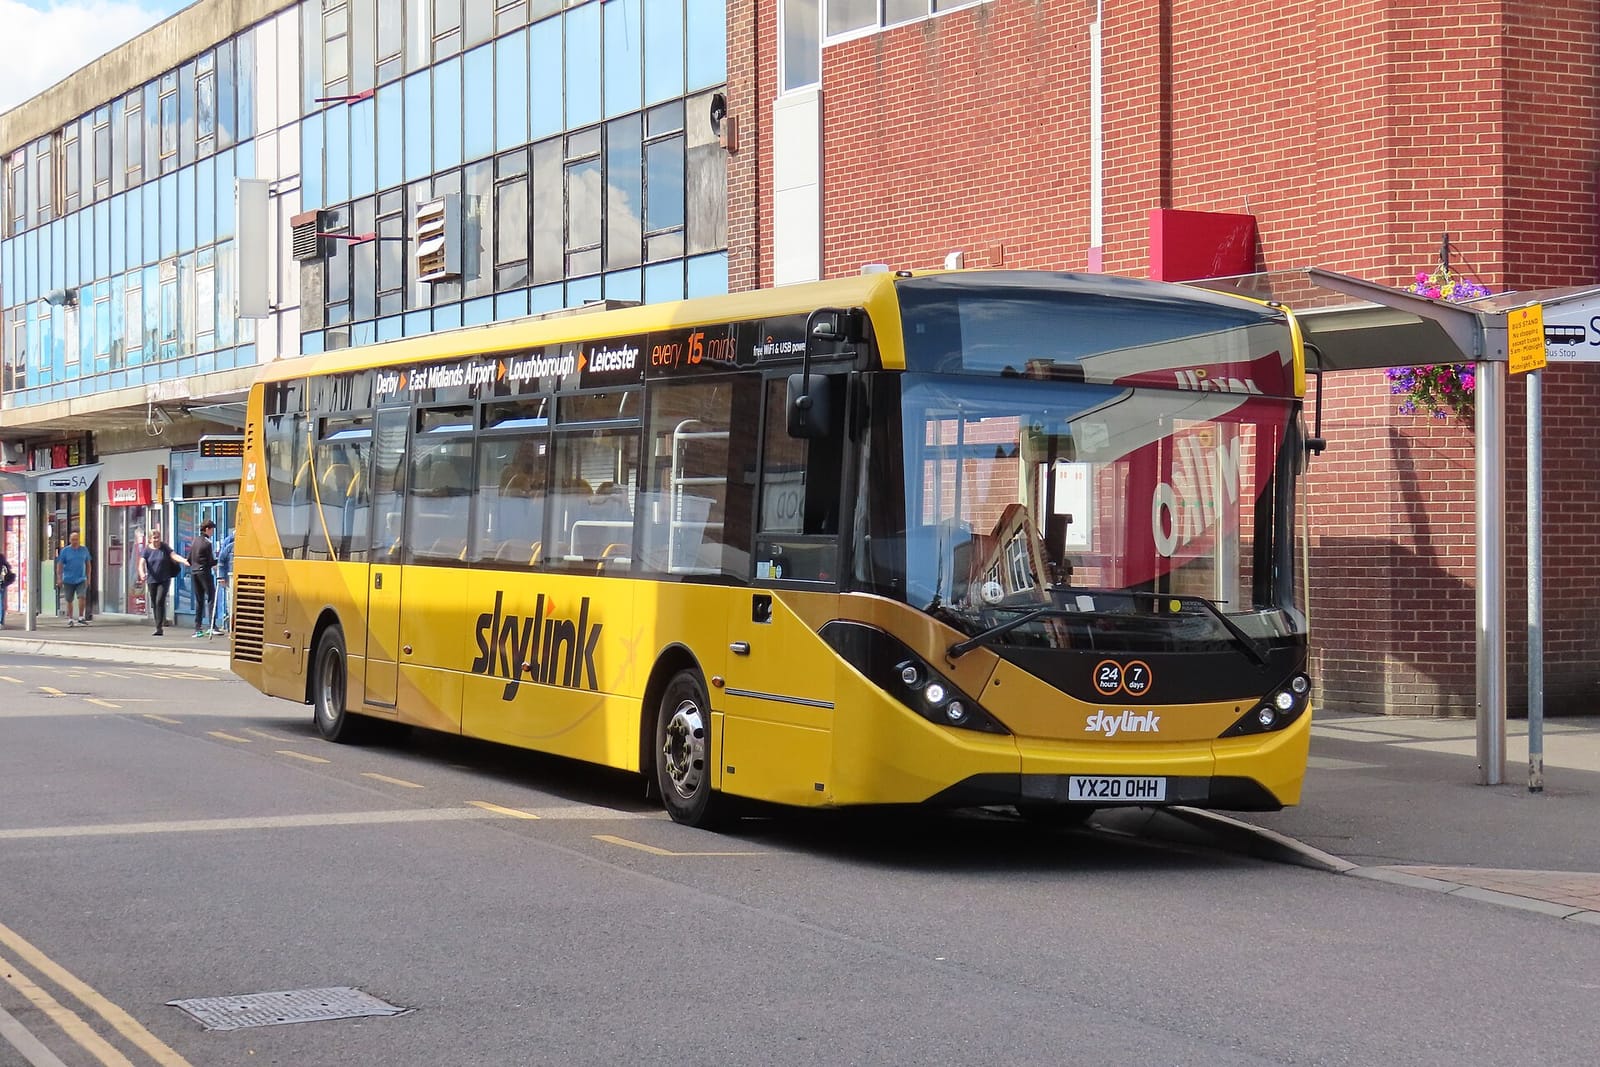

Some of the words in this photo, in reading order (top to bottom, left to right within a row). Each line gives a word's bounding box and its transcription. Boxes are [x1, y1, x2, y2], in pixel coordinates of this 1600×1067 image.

[1522, 318, 1538, 328] STAND
[652, 344, 682, 368] every
[687, 333, 704, 364] 15
[708, 332, 736, 361] mins
[774, 344, 780, 354] &
[780, 342, 791, 354] USB
[792, 340, 806, 354] powe
[1560, 348, 1576, 358] Stop
[376, 373, 399, 397] Derby
[408, 369, 428, 390] East
[428, 364, 464, 389] Midlands
[464, 360, 496, 388] Airport
[508, 352, 574, 384] Loughborough
[589, 344, 638, 372] Leicester
[72, 476, 88, 487] SA
[472, 590, 603, 701] skylink
[1100, 667, 1118, 680] 24
[1134, 668, 1142, 680] 7
[1129, 681, 1144, 689] days
[1084, 710, 1160, 736] skylink
[1077, 780, 1120, 796] YX20
[1125, 780, 1158, 797] OHH
